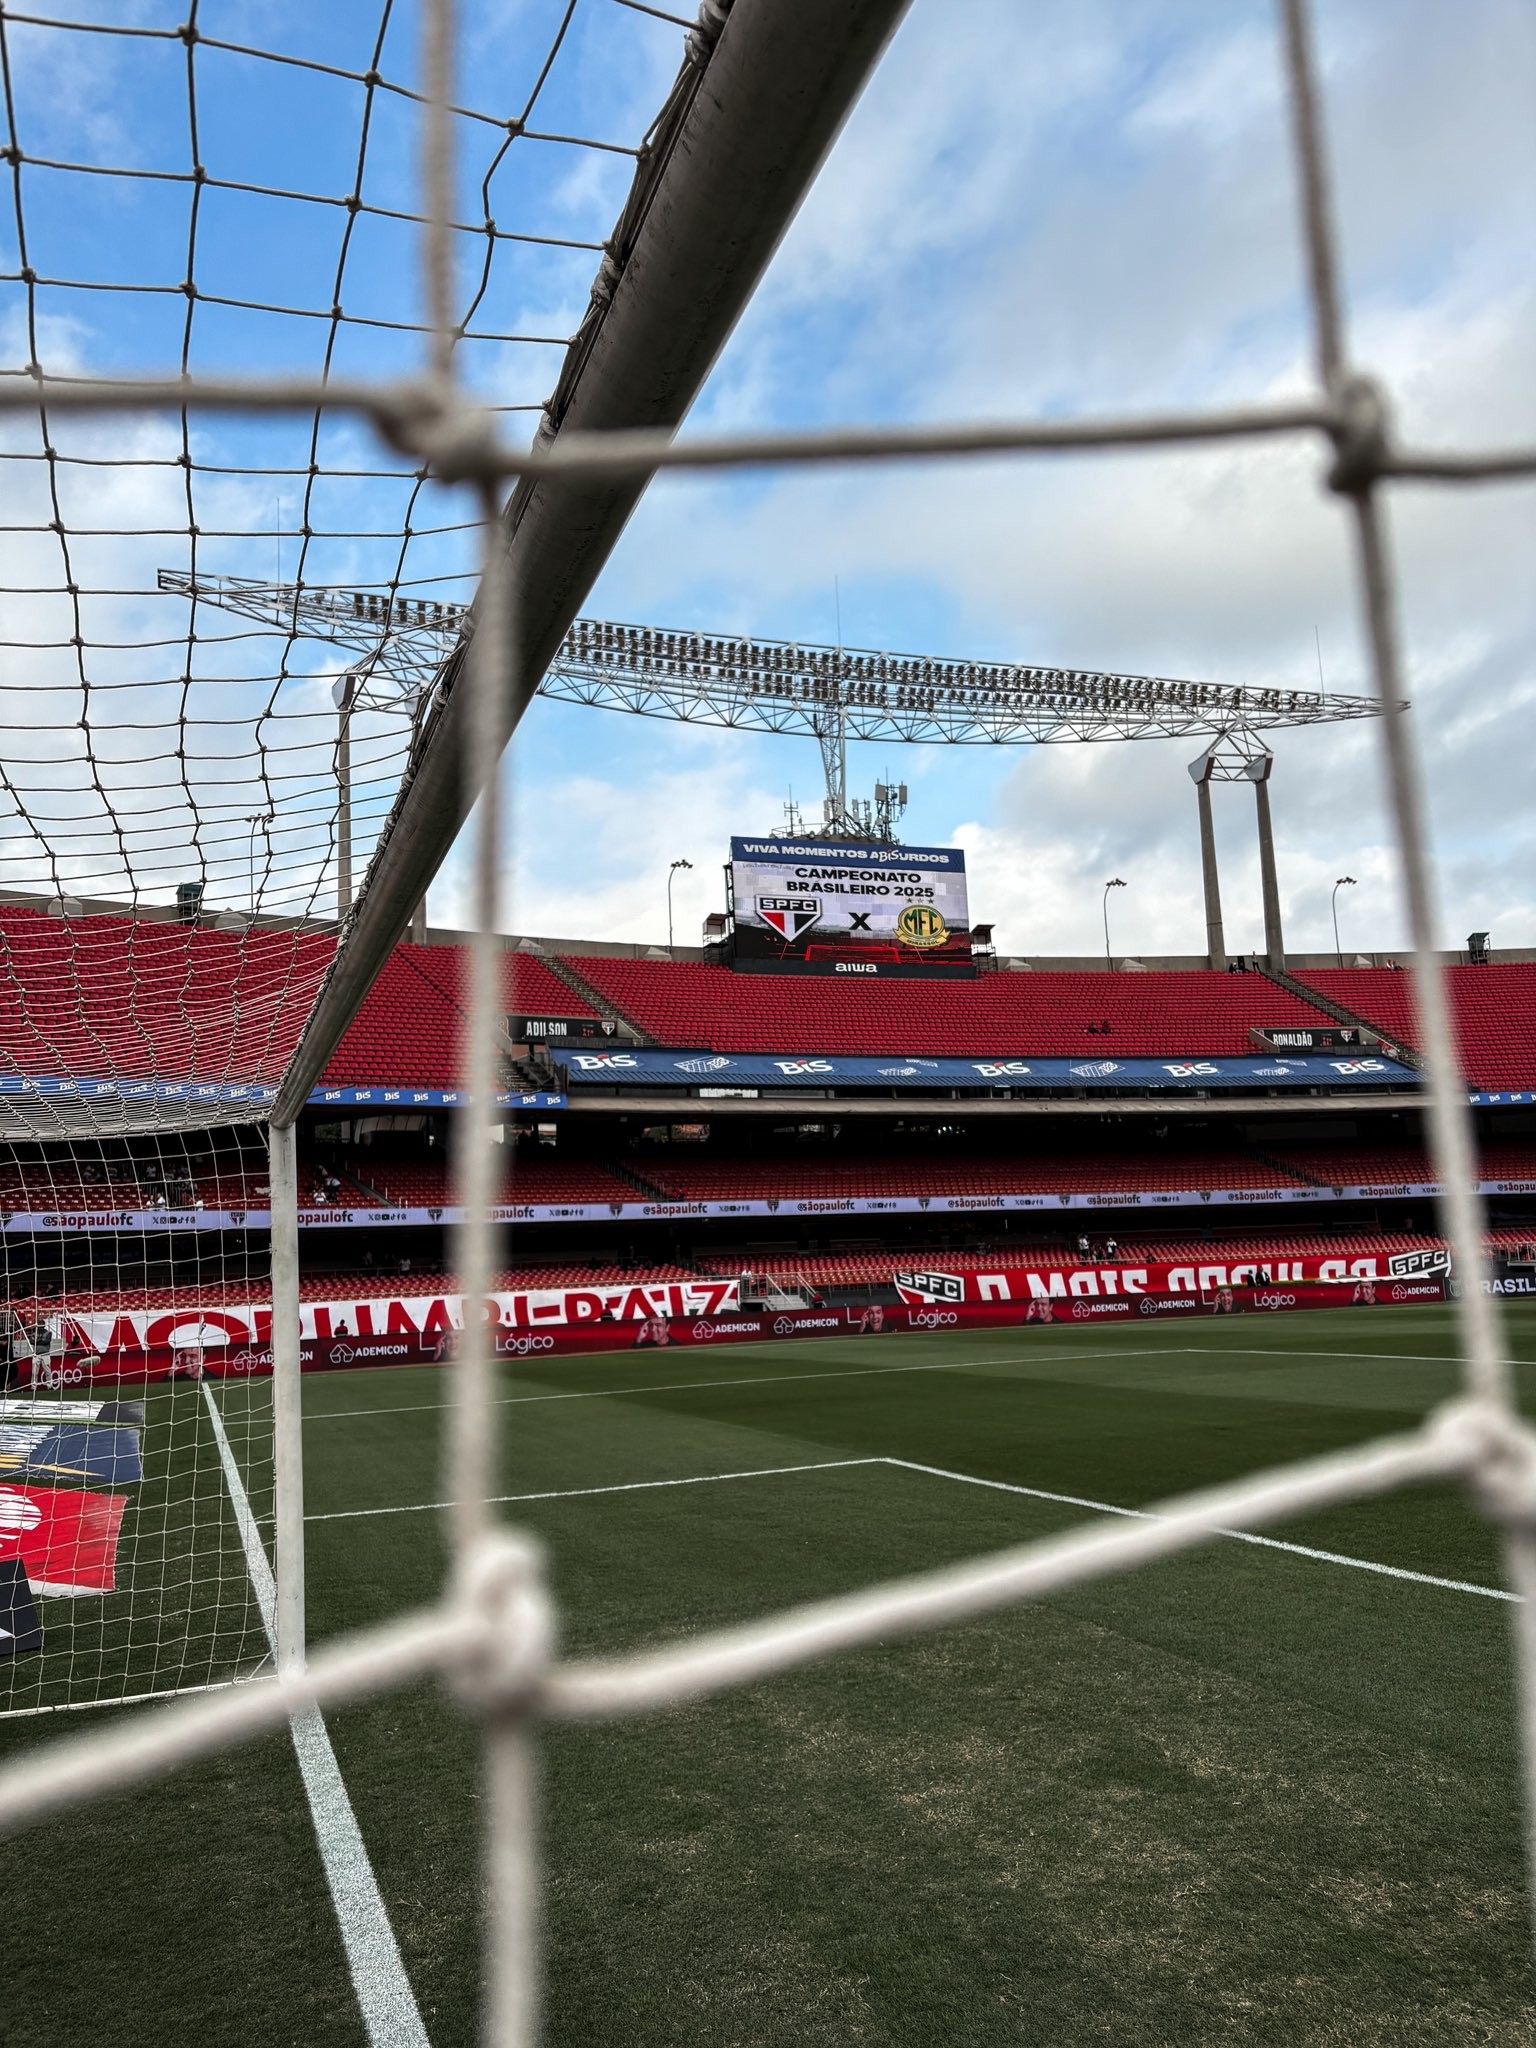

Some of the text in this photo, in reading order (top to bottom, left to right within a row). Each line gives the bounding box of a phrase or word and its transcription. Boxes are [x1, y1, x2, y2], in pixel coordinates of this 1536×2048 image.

[743, 844, 779, 854] VIVA
[782, 846, 867, 859] MOMENTOS
[795, 868, 921, 883] CAMPEONATO
[787, 881, 934, 898] BRASILEIRO 2025
[762, 899, 815, 911] SPFC
[904, 909, 939, 936] MFC
[835, 963, 878, 973] aiwa
[526, 1021, 567, 1037] ADILSON
[1273, 1031, 1313, 1047] RONALDÃO
[643, 1202, 708, 1216] @sãopaulofc
[948, 1197, 1005, 1211] @sãopaulofc
[297, 1210, 353, 1226] opaulofc
[1395, 1251, 1445, 1275] SPFC
[899, 1273, 958, 1298] SPFC
[1407, 1286, 1440, 1295] ADEMICON
[1091, 1303, 1129, 1312] ADEMICON
[1157, 1299, 1196, 1309] ADEMICON
[1254, 1292, 1296, 1309] Lógico
[795, 1317, 839, 1330] ADEMICON
[908, 1309, 957, 1329] Lógico
[715, 1322, 761, 1333] ADEMICON
[355, 1345, 408, 1357] ADEMICON
[496, 1333, 554, 1356] Lógico
